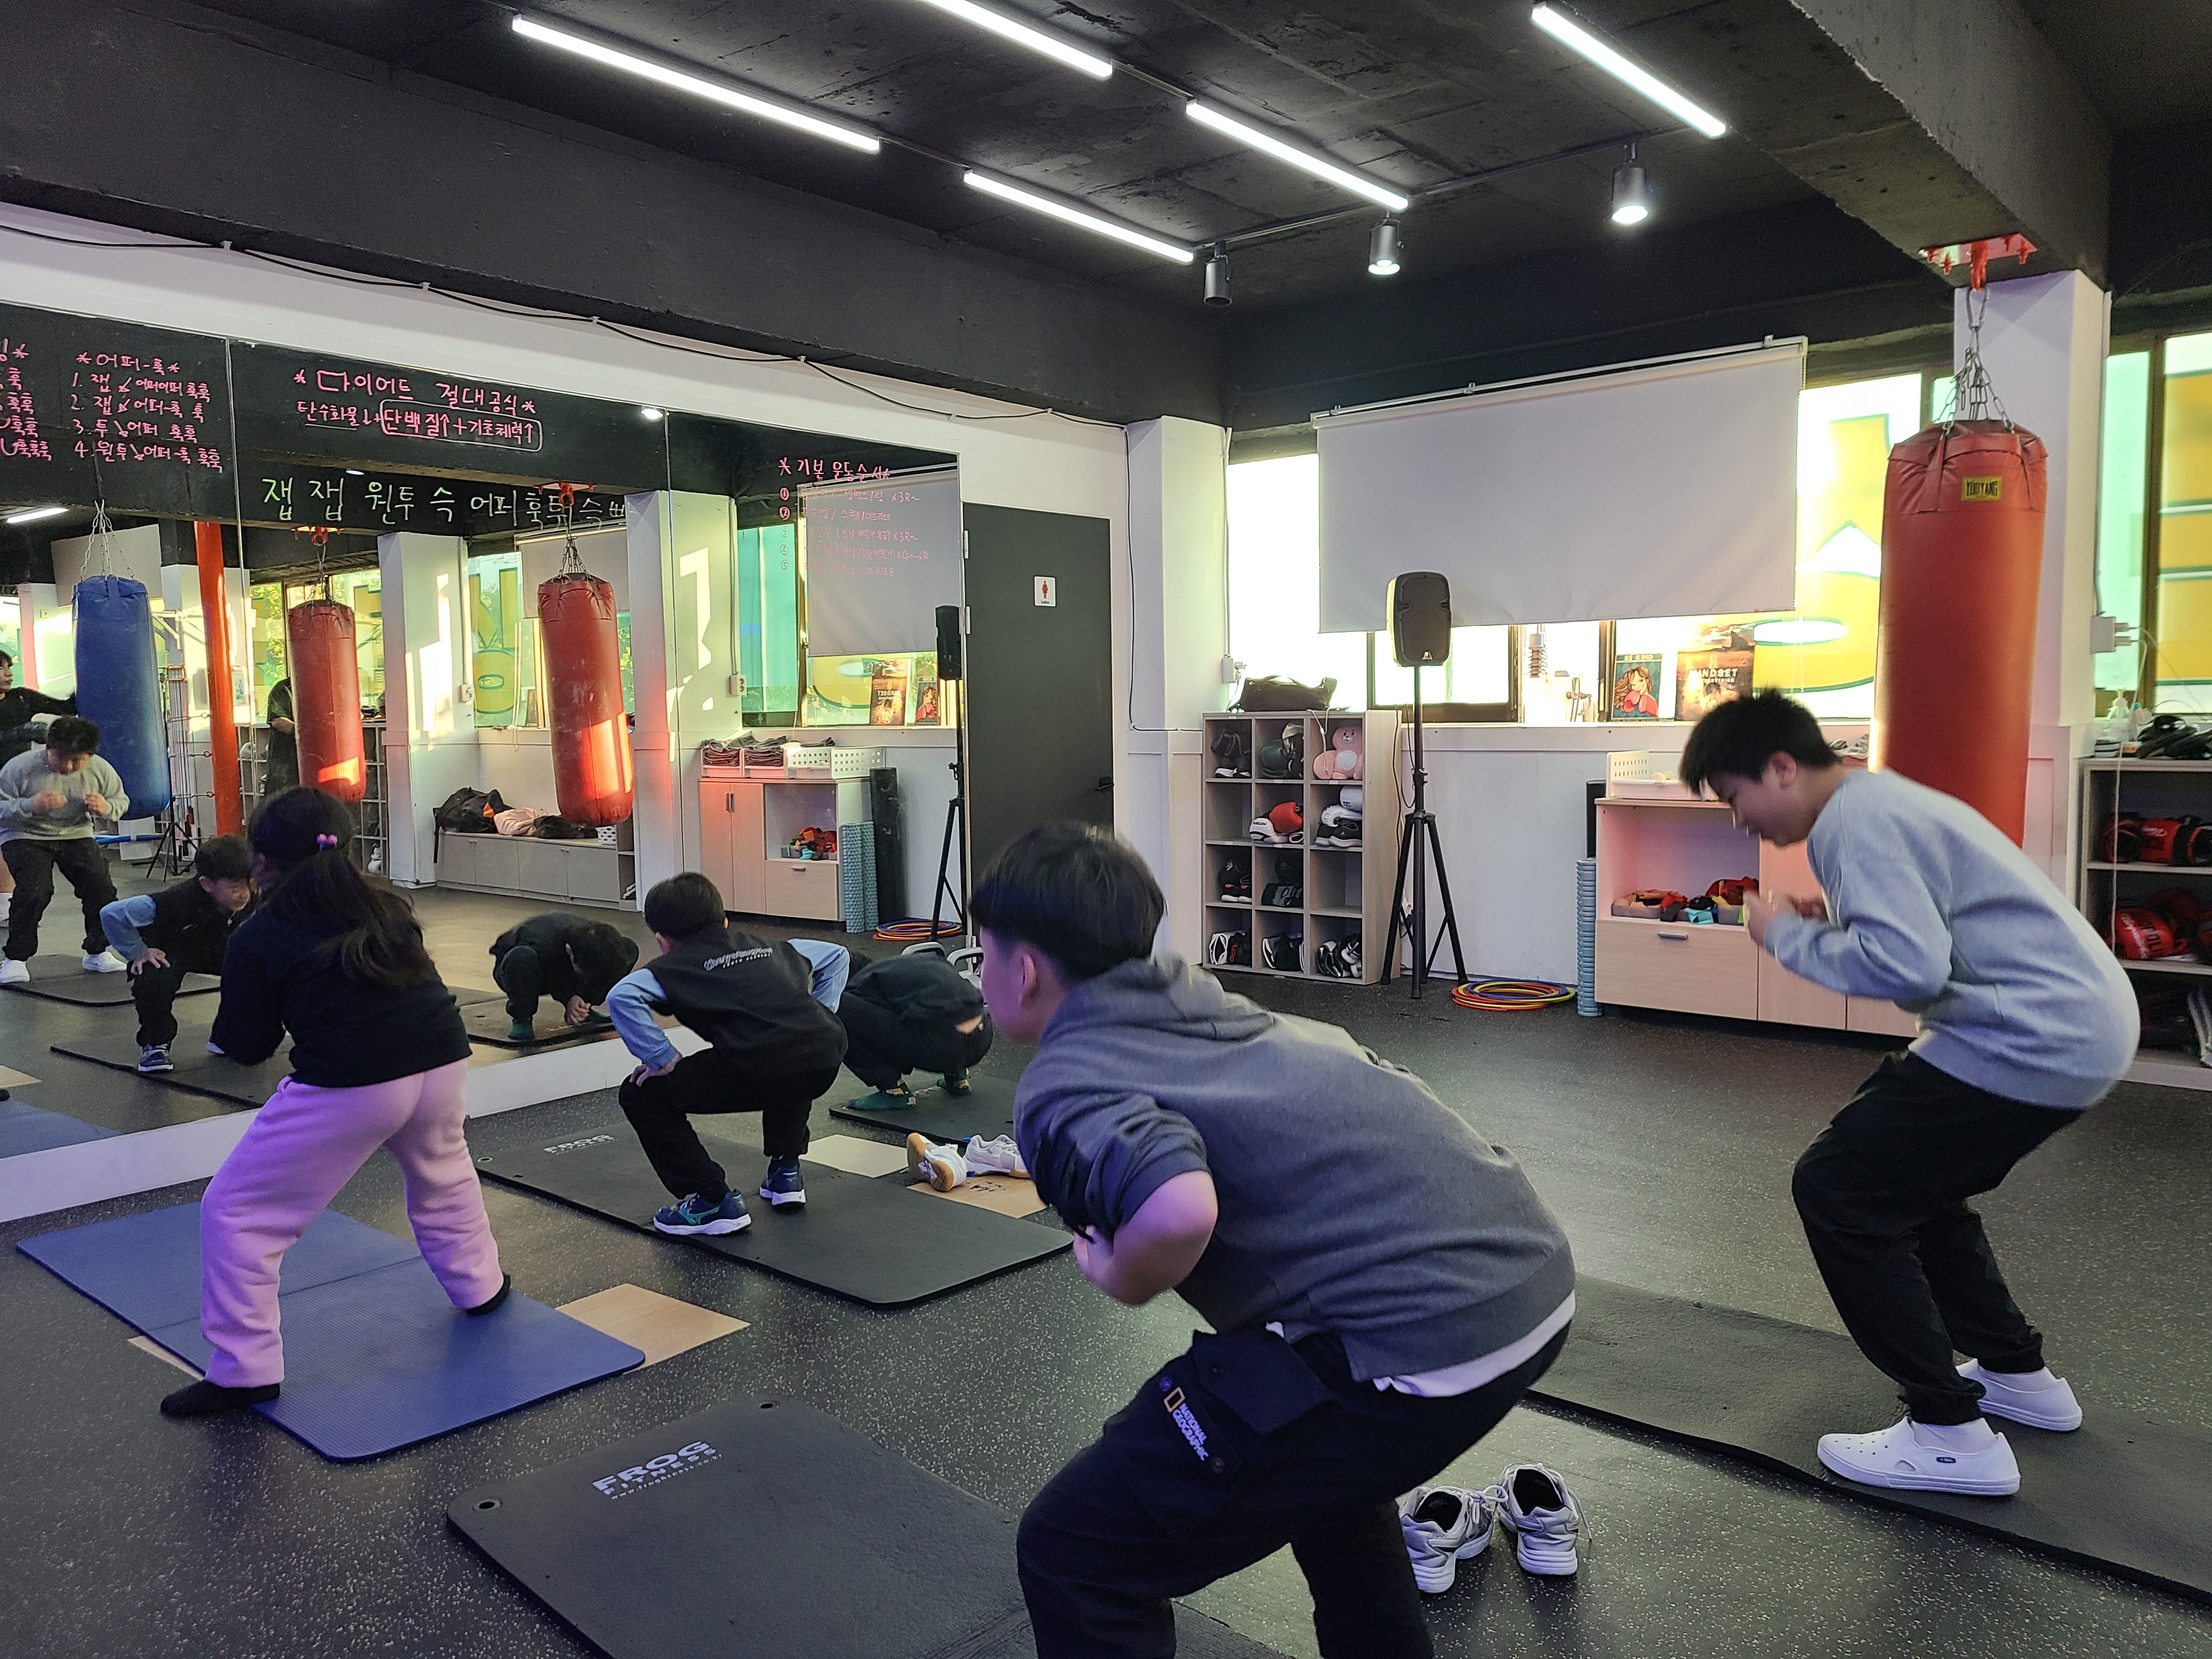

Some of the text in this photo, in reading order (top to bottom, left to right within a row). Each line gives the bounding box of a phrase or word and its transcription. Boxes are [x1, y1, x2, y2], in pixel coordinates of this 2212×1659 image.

[91, 374, 111, 393] 잽
[317, 370, 414, 400] 다이어트
[94, 395, 112, 416] 잽
[297, 401, 360, 426] 탄수화물
[95, 419, 109, 438] 투
[127, 421, 158, 436] 어퍼
[95, 441, 128, 462] 원투
[797, 459, 825, 479] 기본
[262, 477, 293, 521] 잽
[308, 477, 344, 521] 잽
[364, 482, 414, 525] 원투
[430, 487, 455, 522] 슥
[579, 498, 603, 531] 슥
[1689, 668, 1738, 678] NDSET
[592, 1441, 710, 1491] FROG
[603, 1448, 716, 1496] FITNESS
